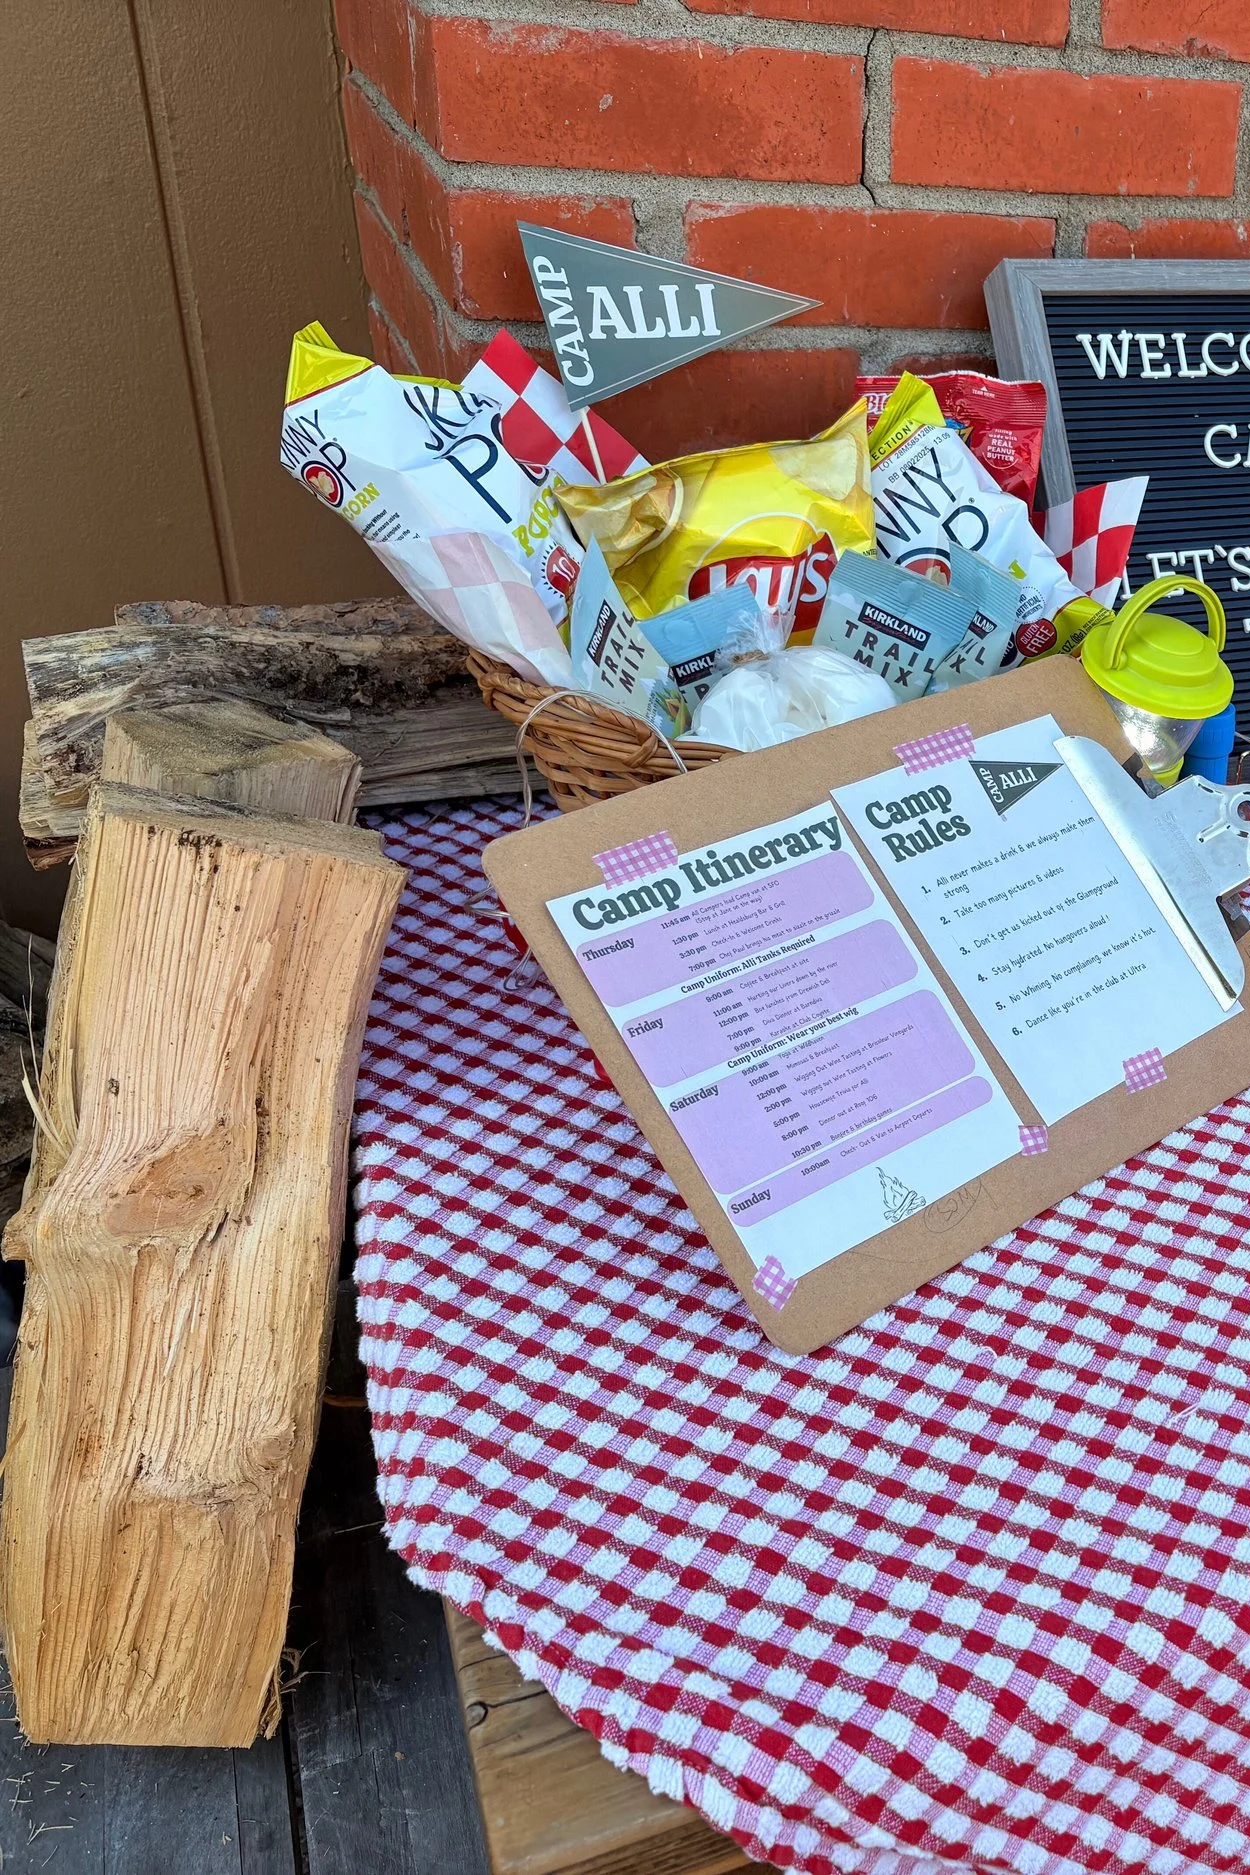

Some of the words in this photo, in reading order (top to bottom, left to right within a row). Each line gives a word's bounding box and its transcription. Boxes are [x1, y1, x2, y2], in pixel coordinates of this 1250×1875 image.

[533, 255, 595, 388] CAMP
[586, 283, 721, 341] ALLI
[987, 446, 1015, 455] PEANUT
[991, 438, 1013, 448] REAL
[879, 458, 895, 472] LOT
[987, 452, 1014, 462] BUTTER
[888, 474, 900, 484] BB
[340, 482, 380, 522] CORN
[1015, 595, 1041, 618] ARTIFICIAL
[588, 604, 612, 657] KIRKLAND
[864, 606, 927, 642] KIRKLAND
[972, 613, 995, 633] KLAND
[1020, 623, 1040, 645] GLUTEN
[601, 611, 635, 688] TRAIL
[845, 620, 935, 674] TRAIL
[1026, 625, 1055, 654] FREE
[1062, 639, 1076, 653] OZ
[619, 639, 645, 694] MIX
[675, 655, 714, 678] KIRKL
[853, 649, 912, 687] MIX
[979, 766, 1004, 804] CAMP
[1000, 767, 1039, 792] ALLI
[864, 784, 952, 839] Camp
[881, 810, 972, 863] Rules
[936, 876, 950, 888] Alli
[949, 869, 969, 882] never
[970, 859, 994, 873] makes
[993, 856, 1000, 864] a
[999, 846, 1019, 861] drink
[1025, 841, 1037, 850] we
[1037, 831, 1060, 845] always
[1059, 823, 1078, 835] make
[1077, 816, 1096, 828] them
[572, 874, 682, 931] Camp
[678, 815, 845, 894] Itinerary
[921, 885, 932, 895] 1.
[943, 883, 970, 899] strong
[953, 906, 974, 918] Take
[973, 900, 987, 910] too
[987, 891, 1009, 905] many
[1007, 879, 1036, 898] pictures
[1043, 866, 1065, 880] videos
[660, 917, 680, 930] 11:45
[679, 915, 691, 923] am
[939, 916, 951, 926] 2.
[973, 933, 998, 949] Don't
[997, 927, 1011, 941] get
[1010, 923, 1021, 932] us
[1018, 910, 1043, 927] kicked
[1042, 906, 1056, 917] out
[1055, 902, 1065, 912] of
[1064, 897, 1077, 907] the
[1076, 875, 1119, 901] Glampground
[581, 937, 635, 962] Thursday
[959, 946, 971, 956] 3.
[991, 963, 1012, 976] Stay
[1042, 942, 1055, 951] No
[1052, 926, 1089, 946] hangovers
[1088, 915, 1107, 930] aloud
[680, 980, 705, 994] Camp
[703, 965, 742, 984] Uniform:
[741, 957, 757, 970] Alli
[755, 949, 782, 964] Tanks
[779, 934, 816, 954] Required
[1008, 993, 1022, 1004] No
[1050, 972, 1063, 983] No
[1101, 948, 1113, 958] we
[1110, 939, 1130, 952] know
[1130, 932, 1143, 944] it's
[977, 973, 988, 983] 4.
[995, 1001, 1007, 1011] 5.
[1024, 1013, 1049, 1029] Dance
[1047, 1006, 1062, 1017] like
[1061, 995, 1085, 1014] you're
[1084, 991, 1093, 999] in
[1091, 984, 1105, 994] the
[1104, 975, 1120, 988] club
[1119, 971, 1129, 981] at
[1127, 963, 1147, 976] Ultra
[626, 1017, 664, 1038] Friday
[718, 1015, 739, 1028] 12:00
[737, 1011, 750, 1022] pm
[1011, 1026, 1023, 1036] 6.
[727, 1054, 752, 1069] Camp
[749, 1038, 788, 1058] Uniform:
[785, 1028, 809, 1042] Wear
[808, 1020, 827, 1035] your
[825, 1012, 844, 1025] best
[842, 1007, 860, 1018] wig
[748, 1073, 769, 1087] 10:00
[768, 1070, 780, 1079] am
[669, 1084, 719, 1113] Saturday
[756, 1087, 776, 1101] 12:00
[775, 1083, 788, 1094] pm
[800, 1158, 831, 1176] 10:00am
[730, 1188, 771, 1215] Sunday
